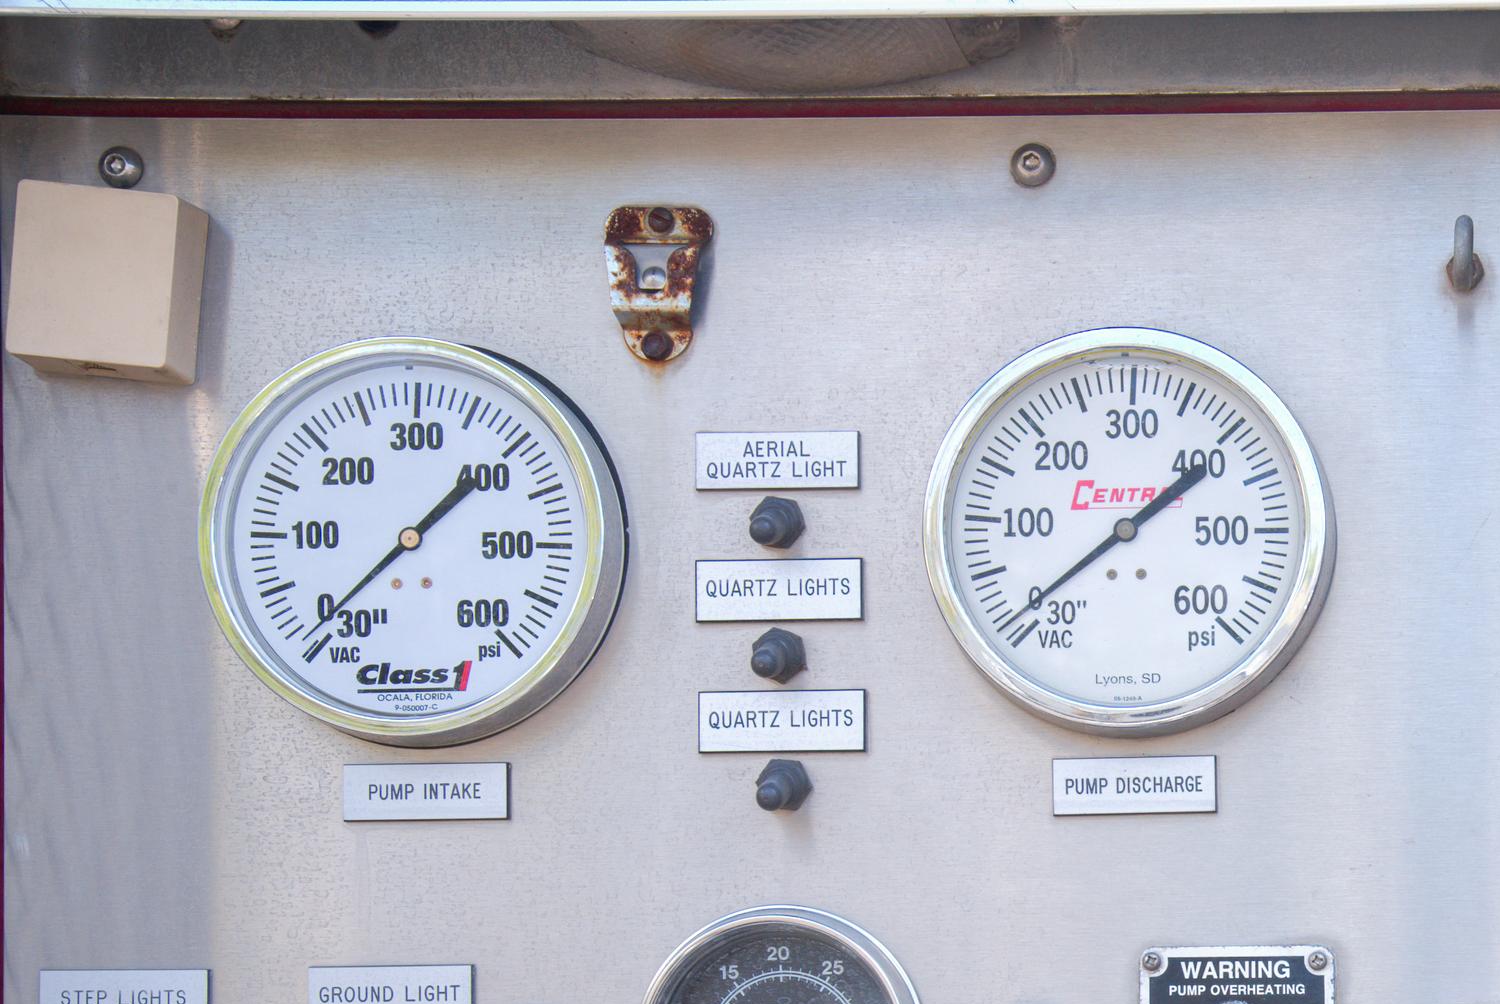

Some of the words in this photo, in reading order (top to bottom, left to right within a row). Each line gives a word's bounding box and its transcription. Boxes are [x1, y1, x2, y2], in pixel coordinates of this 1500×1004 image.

[389, 422, 444, 451] 300
[742, 440, 811, 458] AERIAL
[322, 457, 374, 486] 200
[706, 461, 781, 479] QUARTZ
[792, 459, 848, 477] LIGHT
[481, 531, 533, 559] 500
[705, 579, 777, 597] QUARTZ
[787, 578, 851, 596] LIGHTS
[1095, 674, 1136, 687] Lyons,
[1141, 673, 1161, 684] SD
[377, 694, 412, 702] OCALA,
[708, 710, 780, 729] QUARTZ
[790, 709, 854, 727] LIGHTS
[368, 784, 415, 801] PUMP
[423, 783, 482, 800] INTAKE
[1063, 778, 1108, 796] PUMP
[1115, 775, 1204, 795] DISCHARGE
[766, 947, 790, 960] 20
[1180, 961, 1290, 980] WARNING
[318, 986, 394, 1004] GROUND
[405, 985, 460, 1002] LIGHT
[1169, 985, 1205, 996] PUMP
[1210, 984, 1305, 996] OVERHEATING
